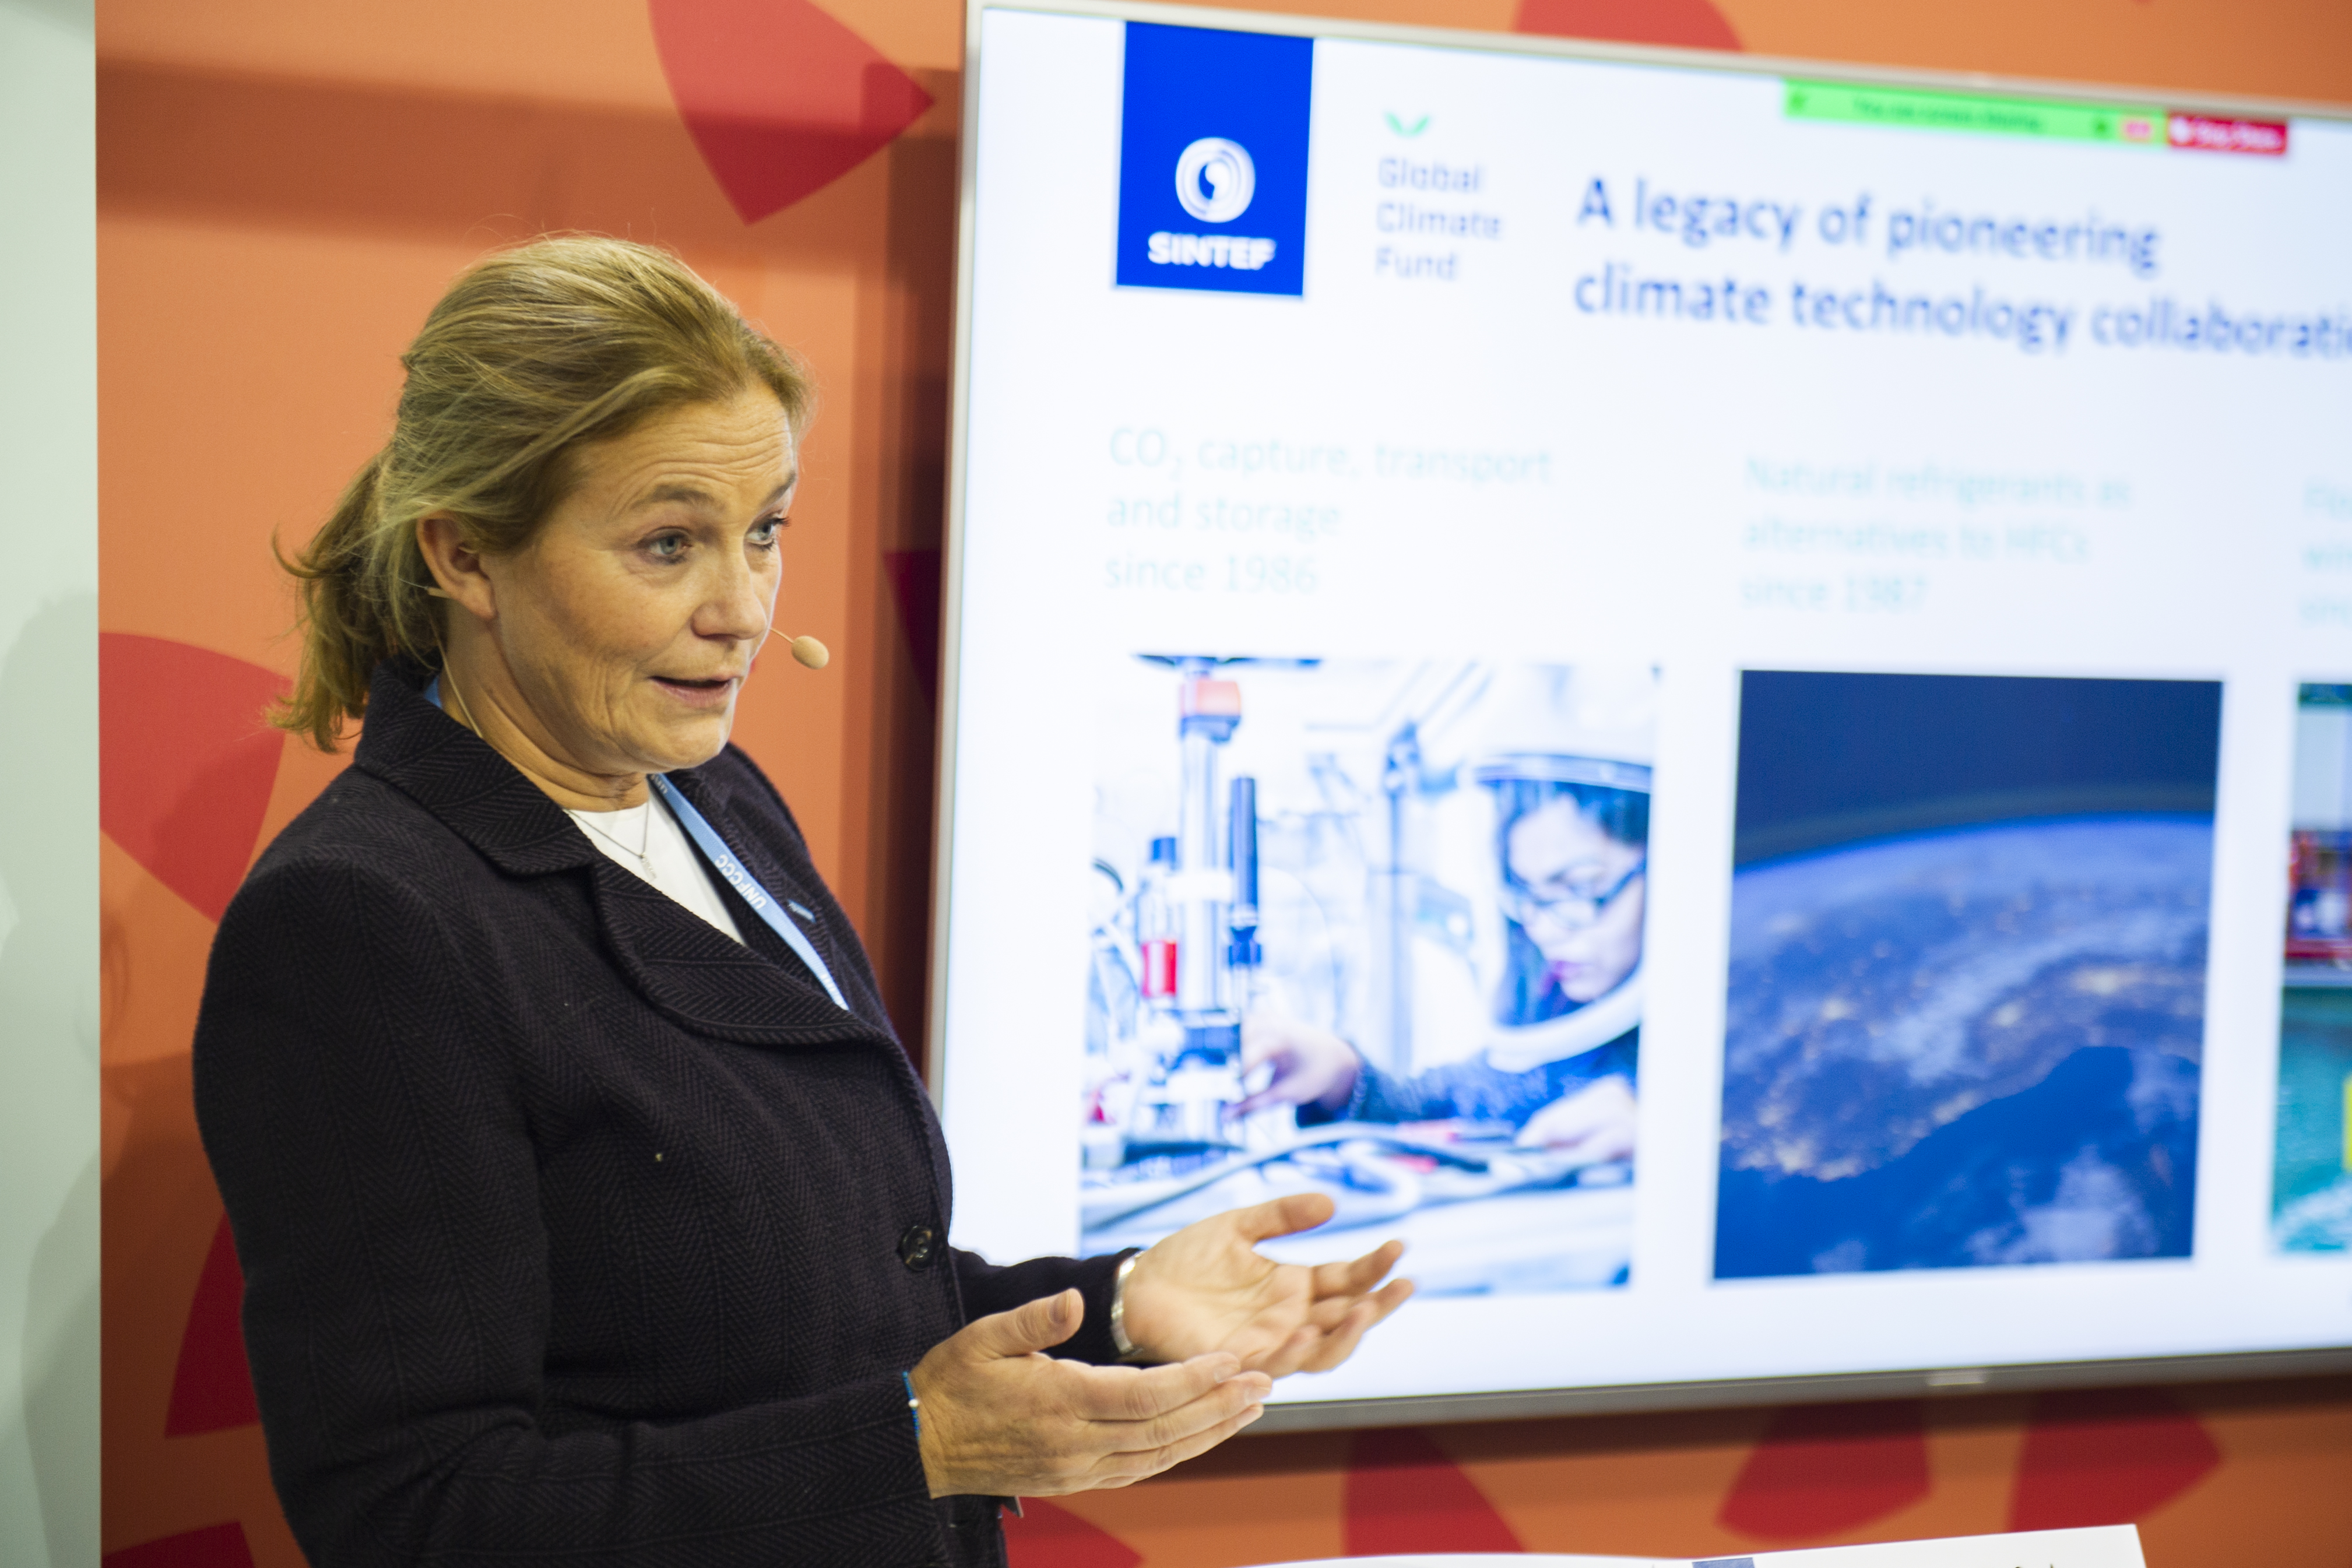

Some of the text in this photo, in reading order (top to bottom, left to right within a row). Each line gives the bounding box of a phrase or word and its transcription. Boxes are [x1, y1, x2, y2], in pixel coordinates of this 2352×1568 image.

[1379, 157, 1482, 194] Global
[1377, 201, 1503, 242] Climate
[1576, 176, 2161, 281] A legacy of pioneering
[1147, 231, 1277, 270] SINTEF
[1376, 245, 1458, 281] Fund
[1574, 261, 2352, 360] climate technology collaborati
[1374, 440, 1553, 491] transport
[1745, 455, 1878, 500] Natural
[1106, 491, 1342, 543] and storage
[1104, 551, 1319, 595] since 1986
[1741, 565, 1829, 612] since
[715, 855, 767, 909] UNFCCC
